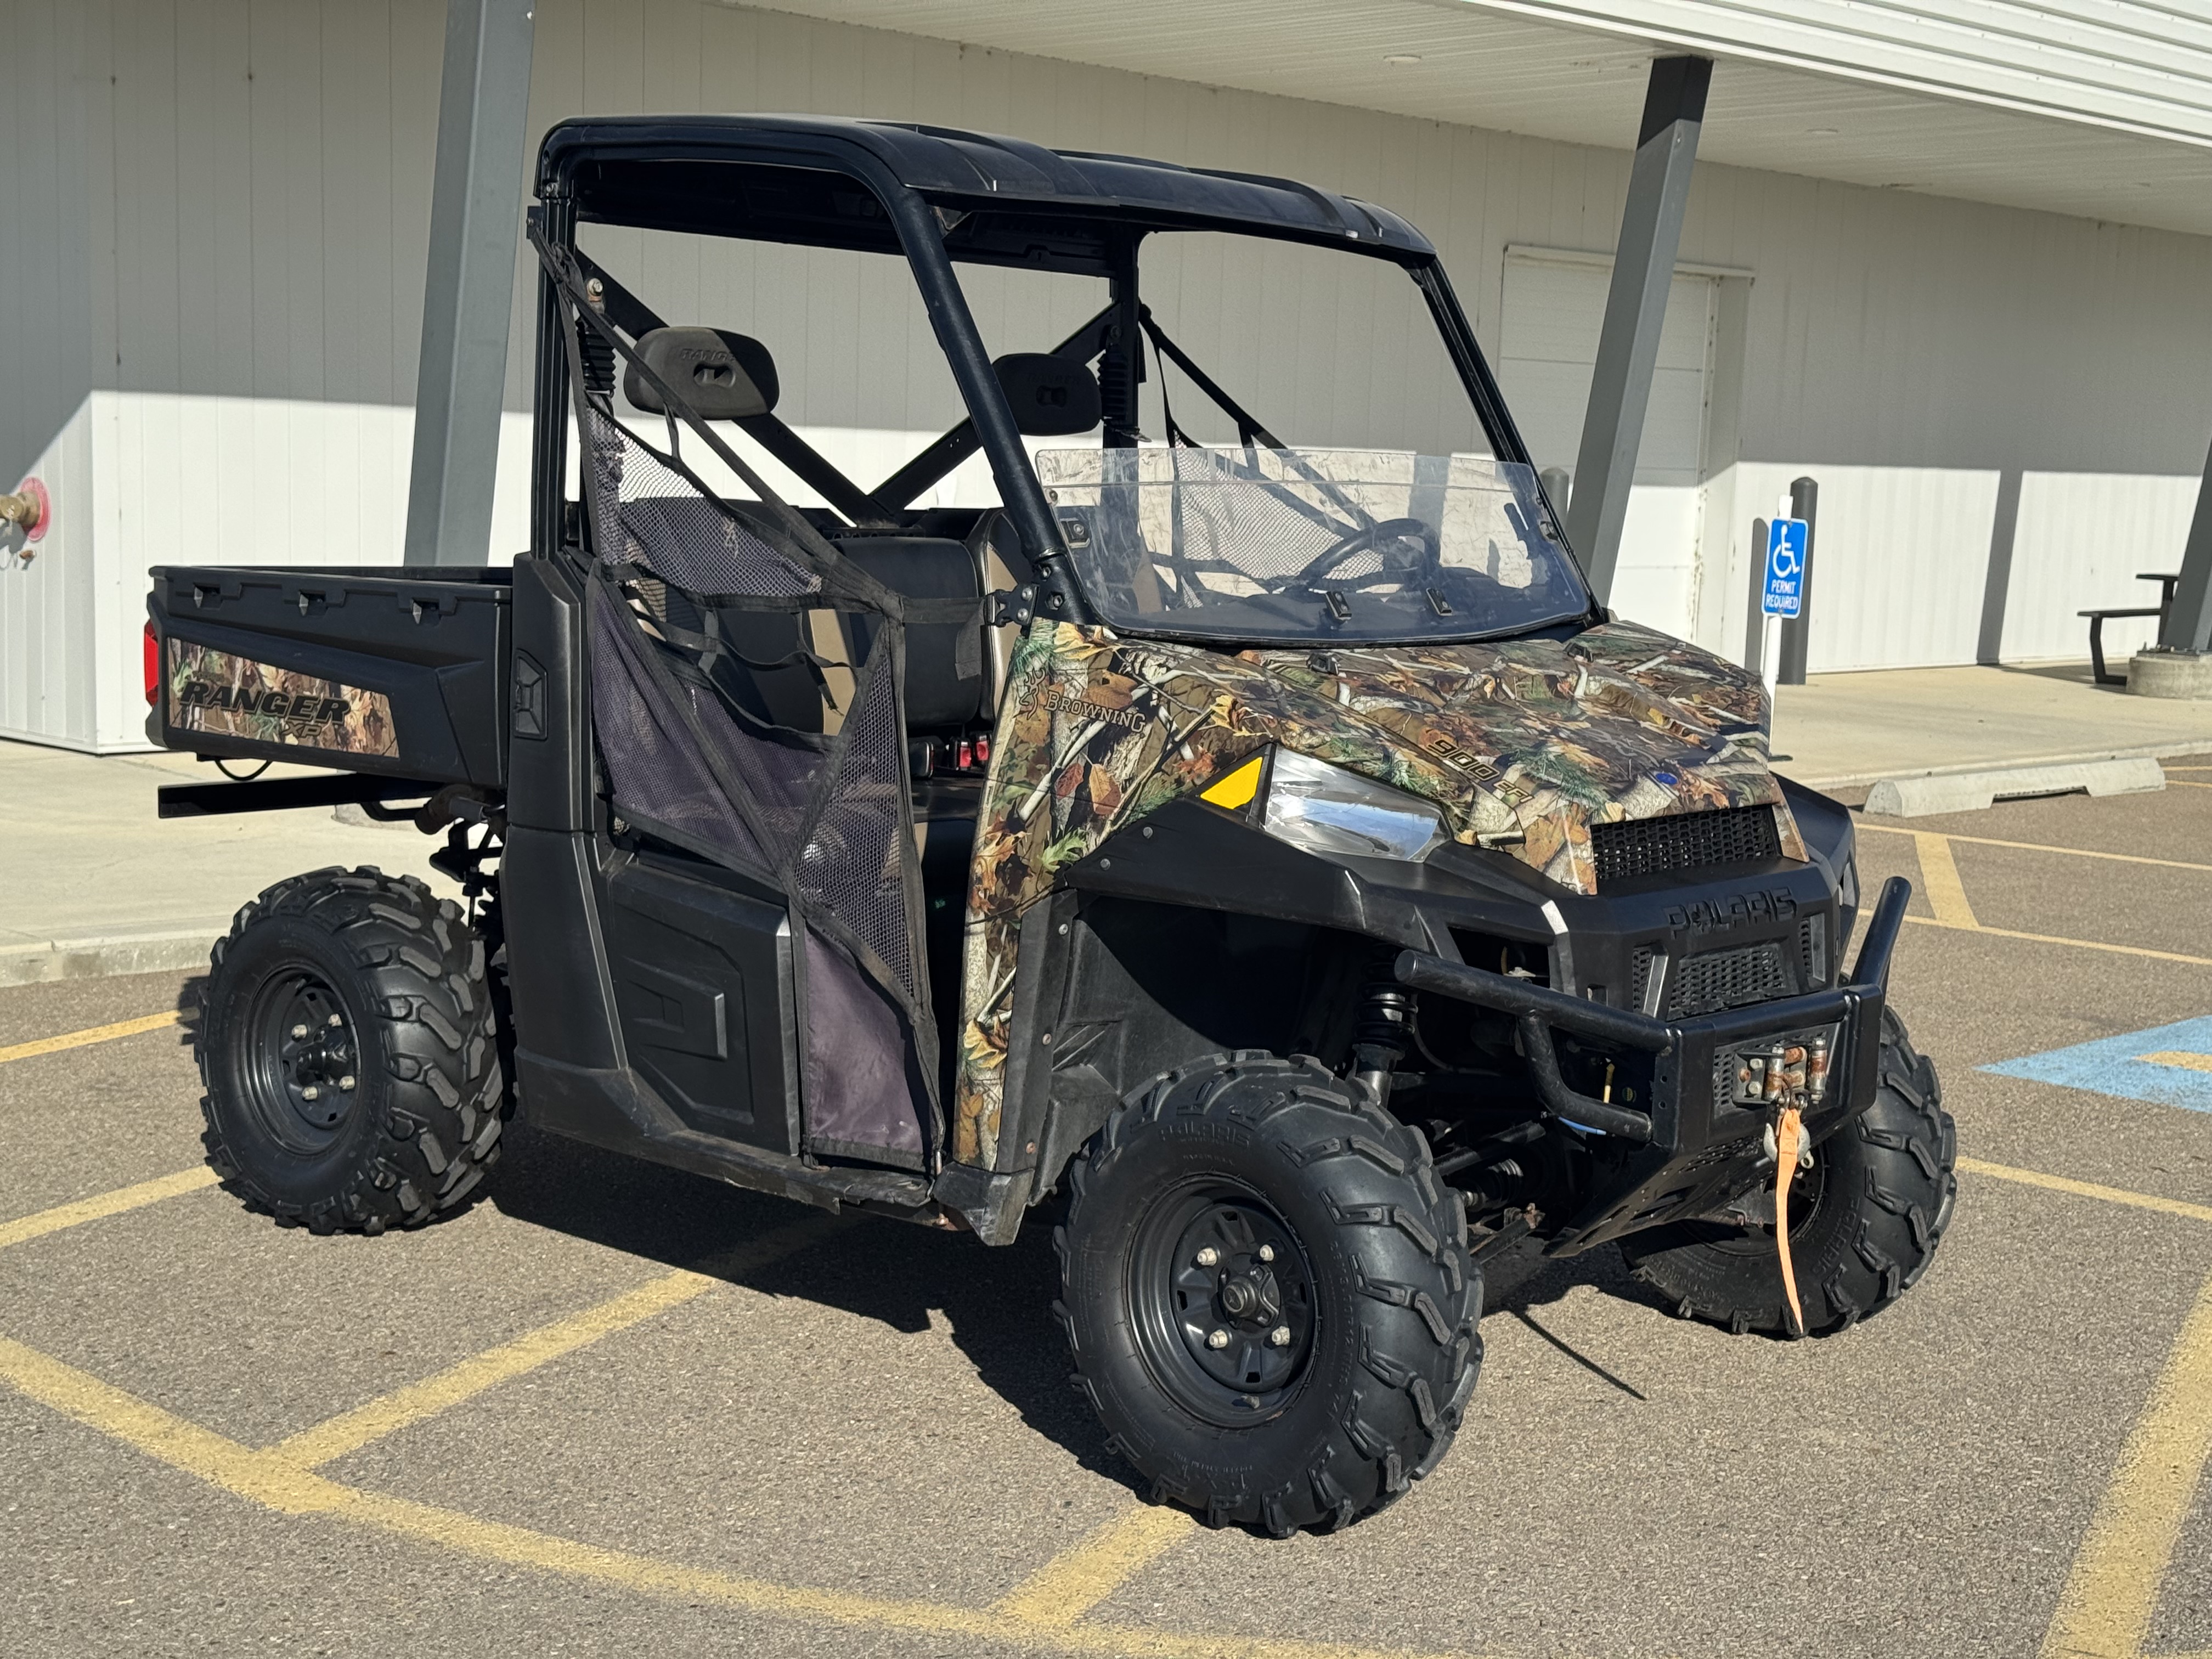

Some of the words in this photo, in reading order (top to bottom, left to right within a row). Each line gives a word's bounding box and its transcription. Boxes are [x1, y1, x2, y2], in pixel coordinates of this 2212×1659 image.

[1765, 593, 1799, 610] REQUIRED
[1771, 579, 1797, 595] PERMIT
[179, 681, 351, 725] RANGER
[1044, 690, 1147, 733] BROWNING
[281, 721, 323, 738] XP
[1426, 738, 1500, 782] 900
[1492, 779, 1534, 804] EFI
[1663, 886, 1797, 940] POLARIS
